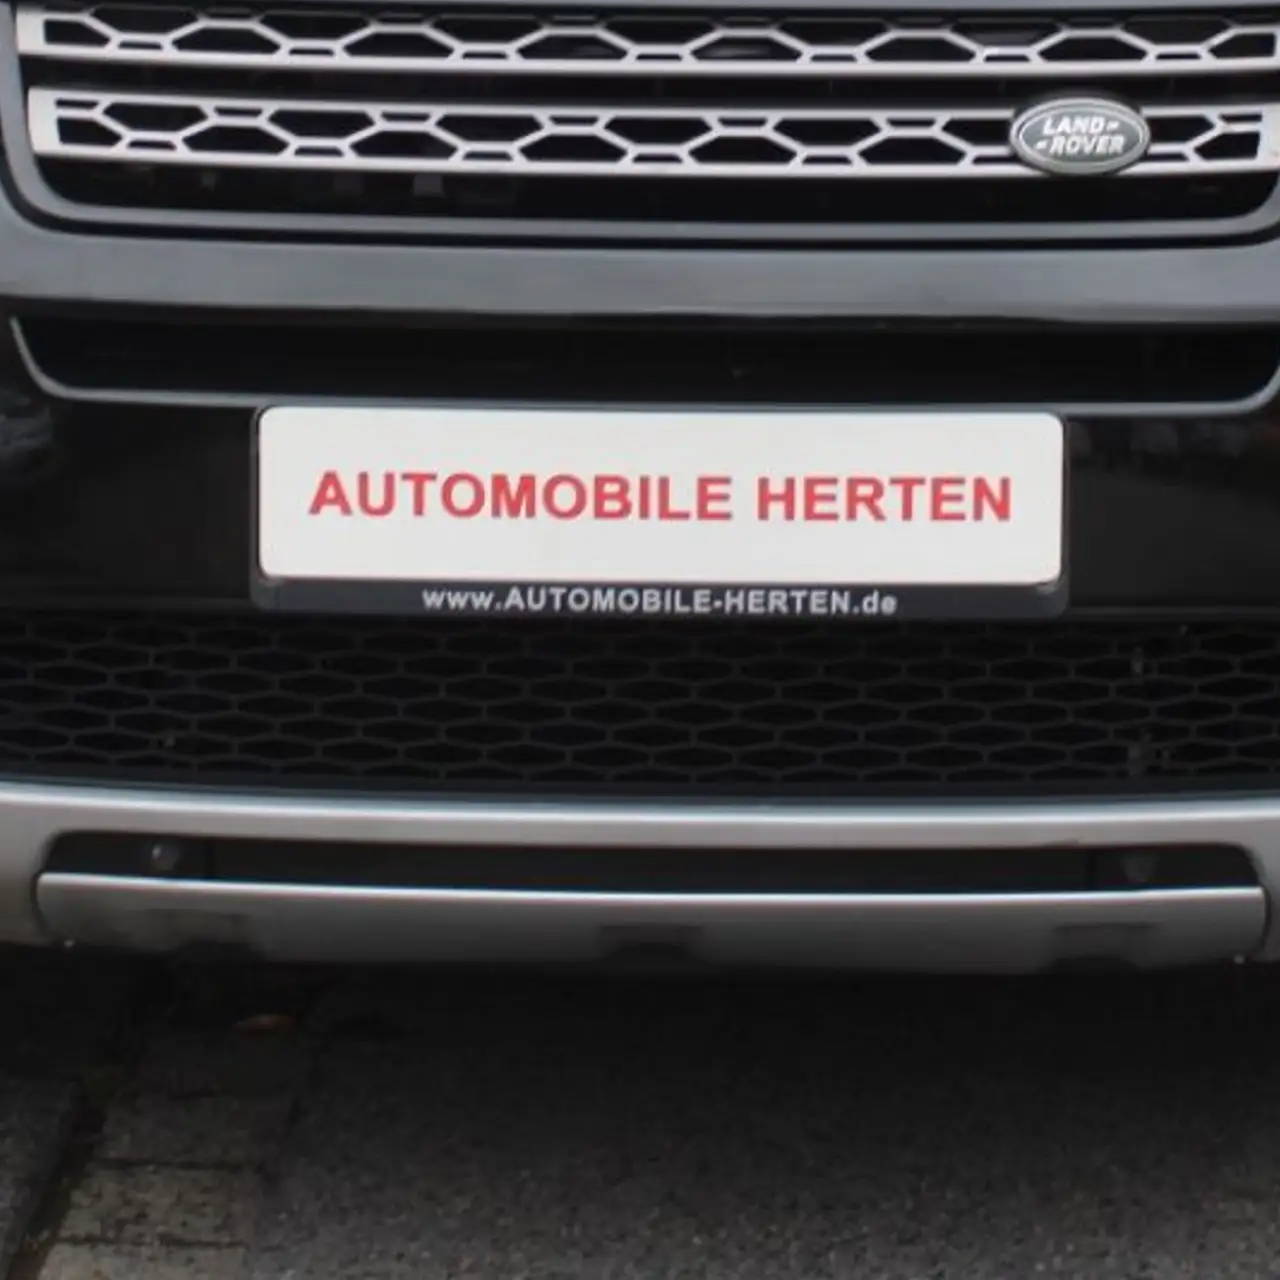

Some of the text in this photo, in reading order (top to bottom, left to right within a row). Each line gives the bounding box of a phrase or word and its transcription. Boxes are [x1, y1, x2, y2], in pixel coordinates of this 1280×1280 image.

[308, 470, 1012, 522] AUTOMOBILE HERTEN
[421, 585, 898, 616] www.AUTOMOBILE-HERTEN.de
